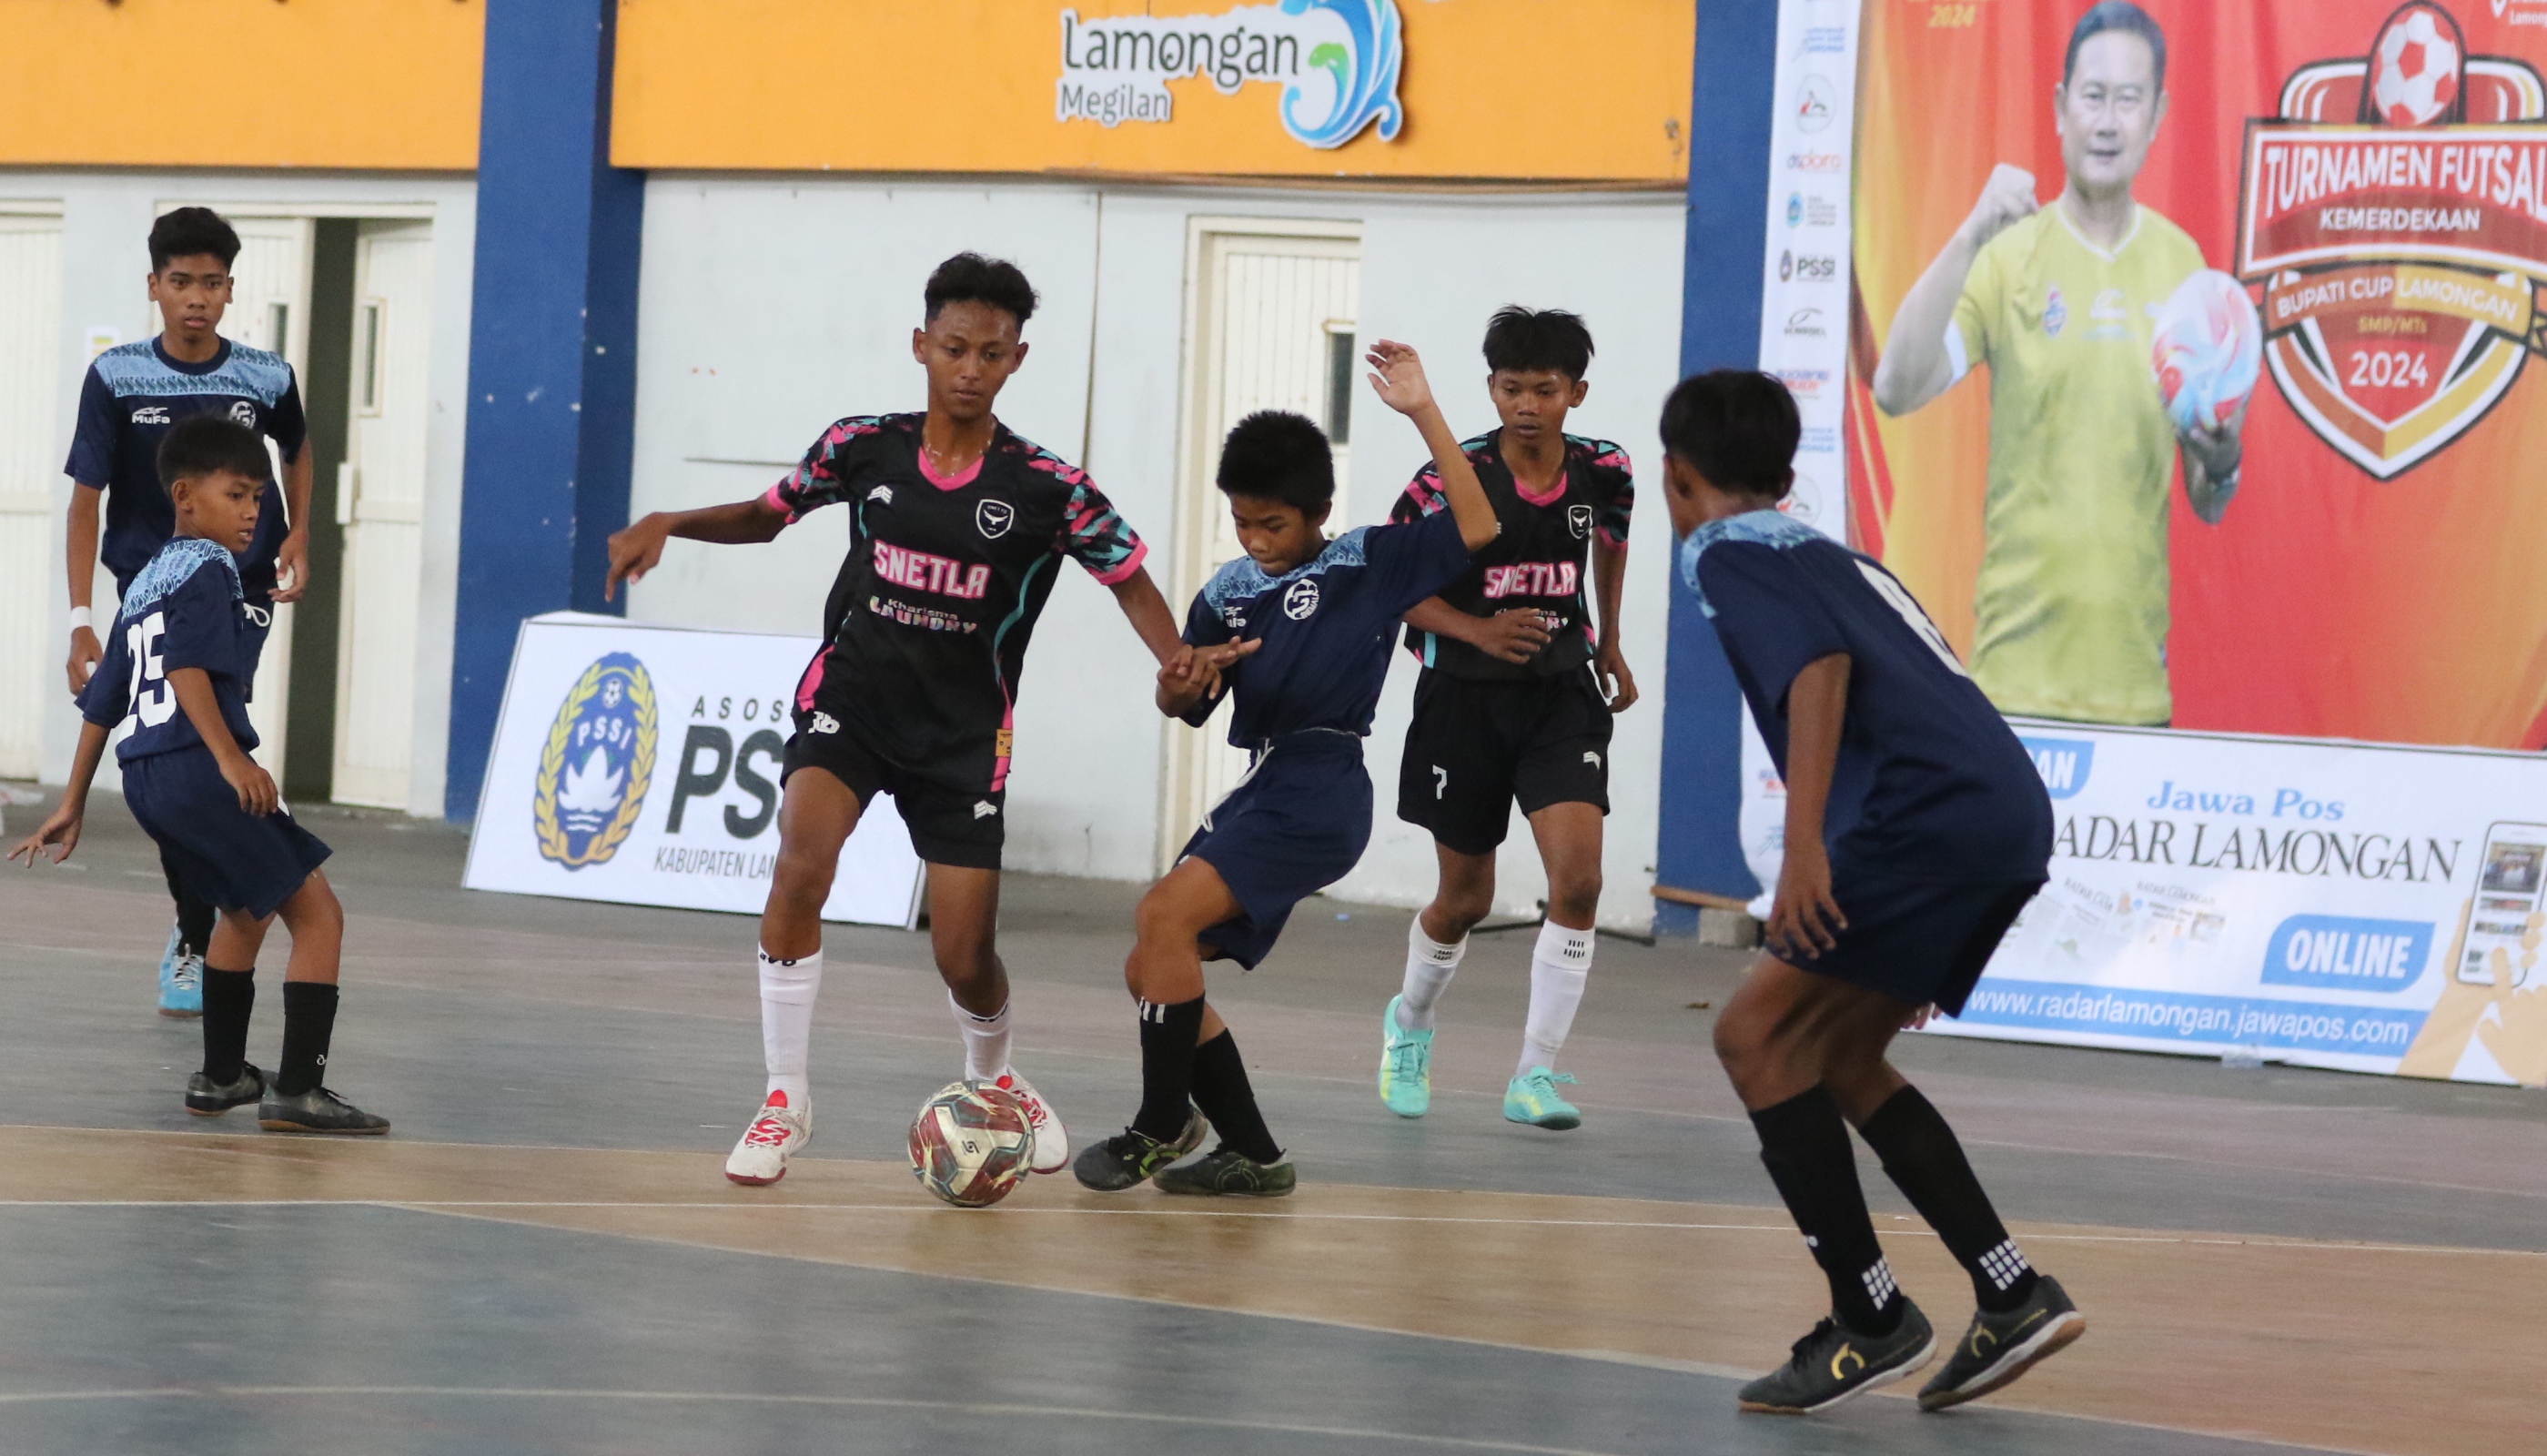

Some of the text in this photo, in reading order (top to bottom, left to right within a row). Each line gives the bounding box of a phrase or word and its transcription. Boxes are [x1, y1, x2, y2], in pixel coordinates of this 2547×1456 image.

[1929, 5, 1976, 28] 2024
[1064, 18, 1299, 88] Lamongan
[1060, 84, 1171, 122] Megilan
[2265, 146, 2433, 219] TURNAMEN
[2320, 207, 2481, 231] KEMERDEKAAN
[1797, 258, 1835, 278] PSSI
[2276, 276, 2519, 322] BUPATI CUP LAMONGAN
[2350, 350, 2430, 388] 2024
[874, 541, 991, 599] SNETLA
[1484, 561, 1577, 598] SNETLA
[869, 595, 977, 634] LAUNDRY
[577, 715, 632, 750] PSSI
[664, 724, 784, 840] PS
[1432, 764, 1448, 800] 7
[2147, 780, 2346, 821] Jawa Pos
[654, 846, 746, 877] KABUPATEN
[2188, 823, 2463, 883] LAMONGAN
[2286, 928, 2412, 980] ONLINE
[1970, 988, 2411, 1043] www.radarlamongan.jawapos.com
